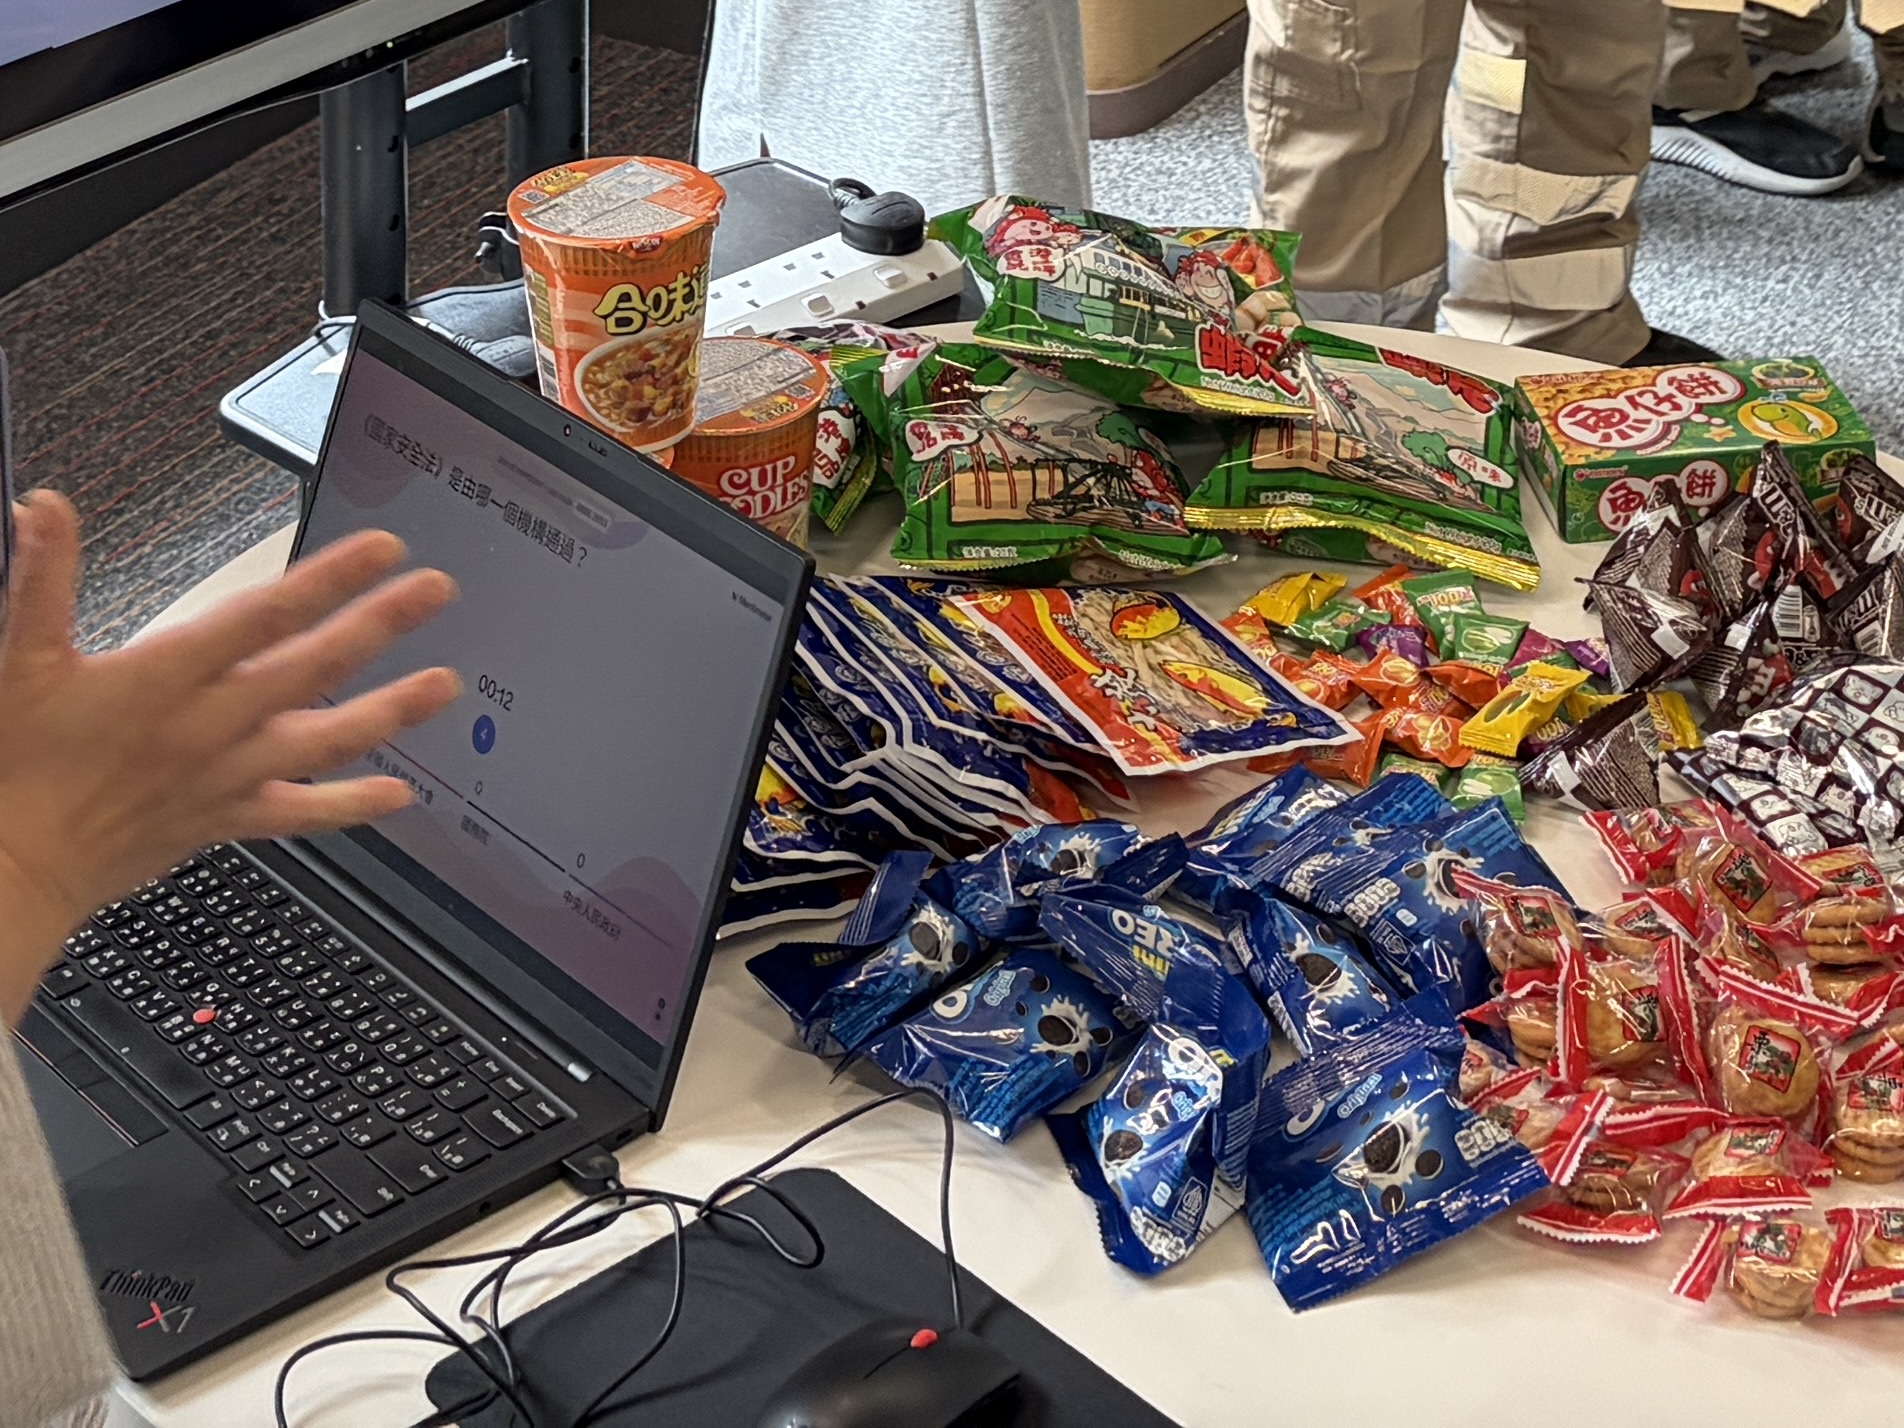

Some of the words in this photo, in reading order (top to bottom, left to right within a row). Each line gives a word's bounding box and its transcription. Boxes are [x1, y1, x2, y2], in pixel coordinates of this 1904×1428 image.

[1563, 371, 1730, 443] 魚仔餅
[720, 455, 796, 495] CUP
[477, 674, 514, 712] 00:12
[1336, 1072, 1383, 1119] Original
